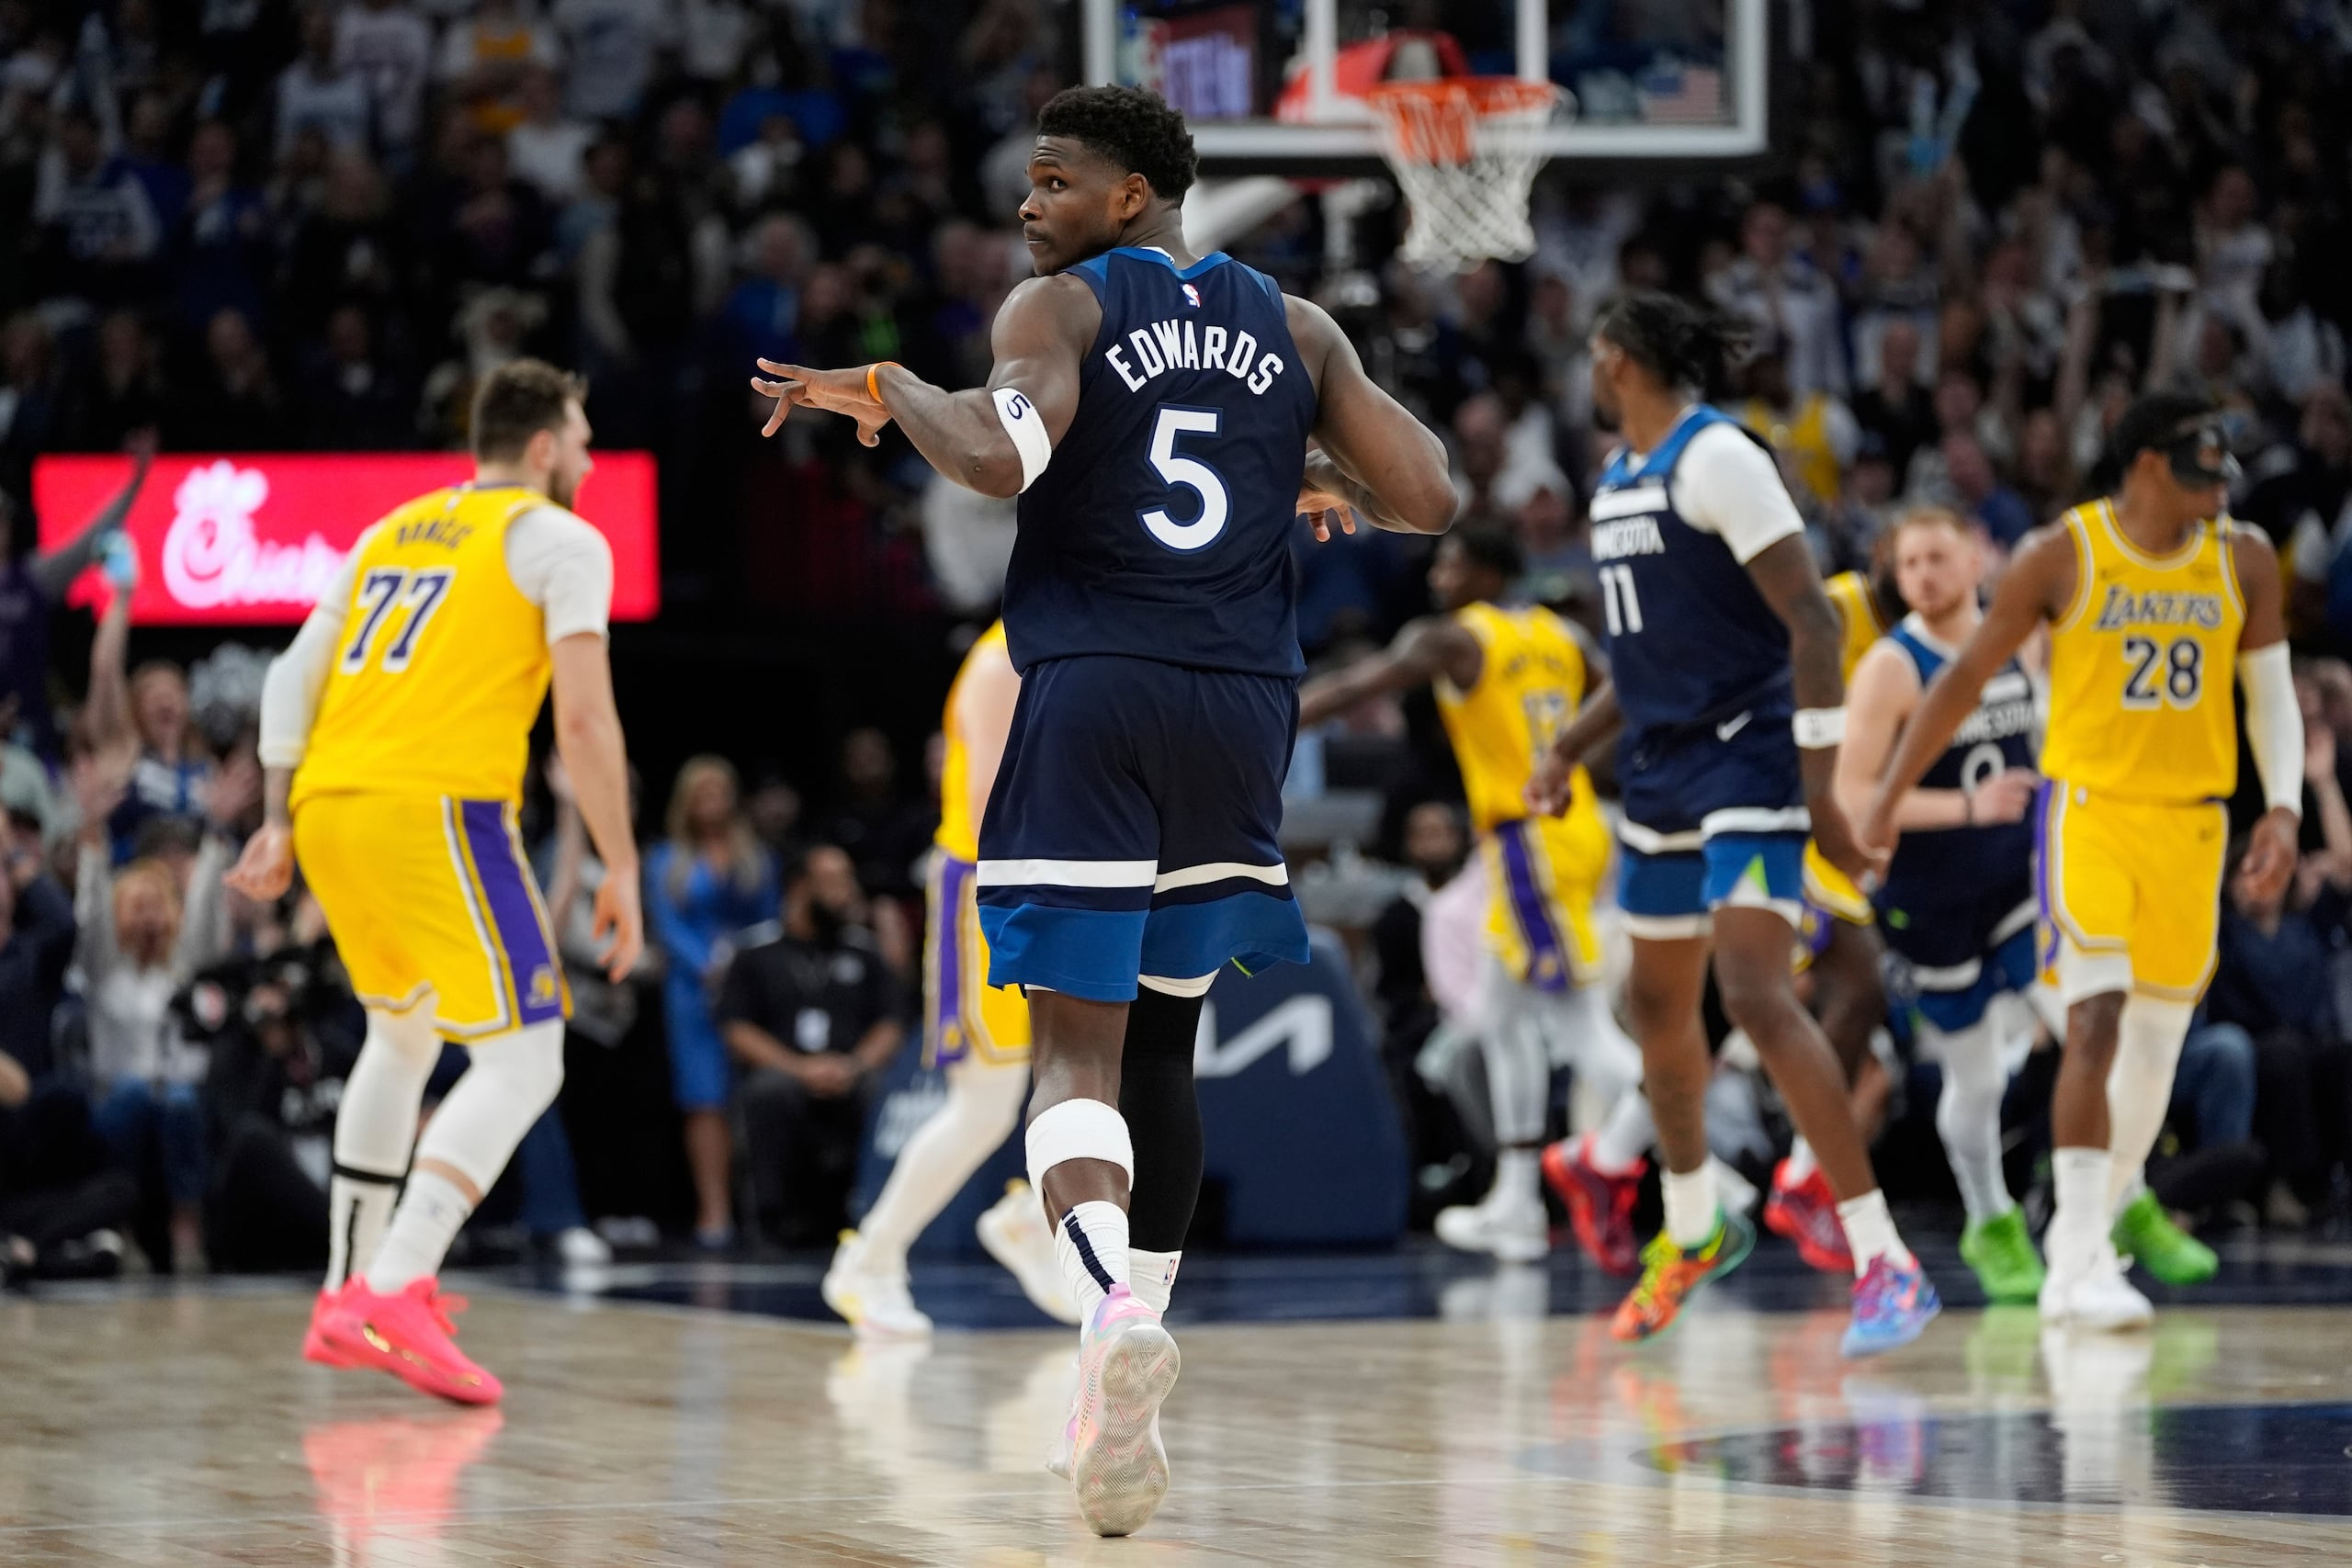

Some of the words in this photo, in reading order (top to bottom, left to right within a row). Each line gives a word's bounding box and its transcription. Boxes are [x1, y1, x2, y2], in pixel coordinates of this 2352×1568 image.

[1105, 319, 1284, 396] EDWARDS
[1005, 393, 1031, 420] 5
[1137, 405, 1231, 554] 5
[343, 567, 455, 674] 77
[1599, 563, 1644, 637] 11
[2091, 584, 2224, 634] LAKERS
[2121, 634, 2204, 711] 28
